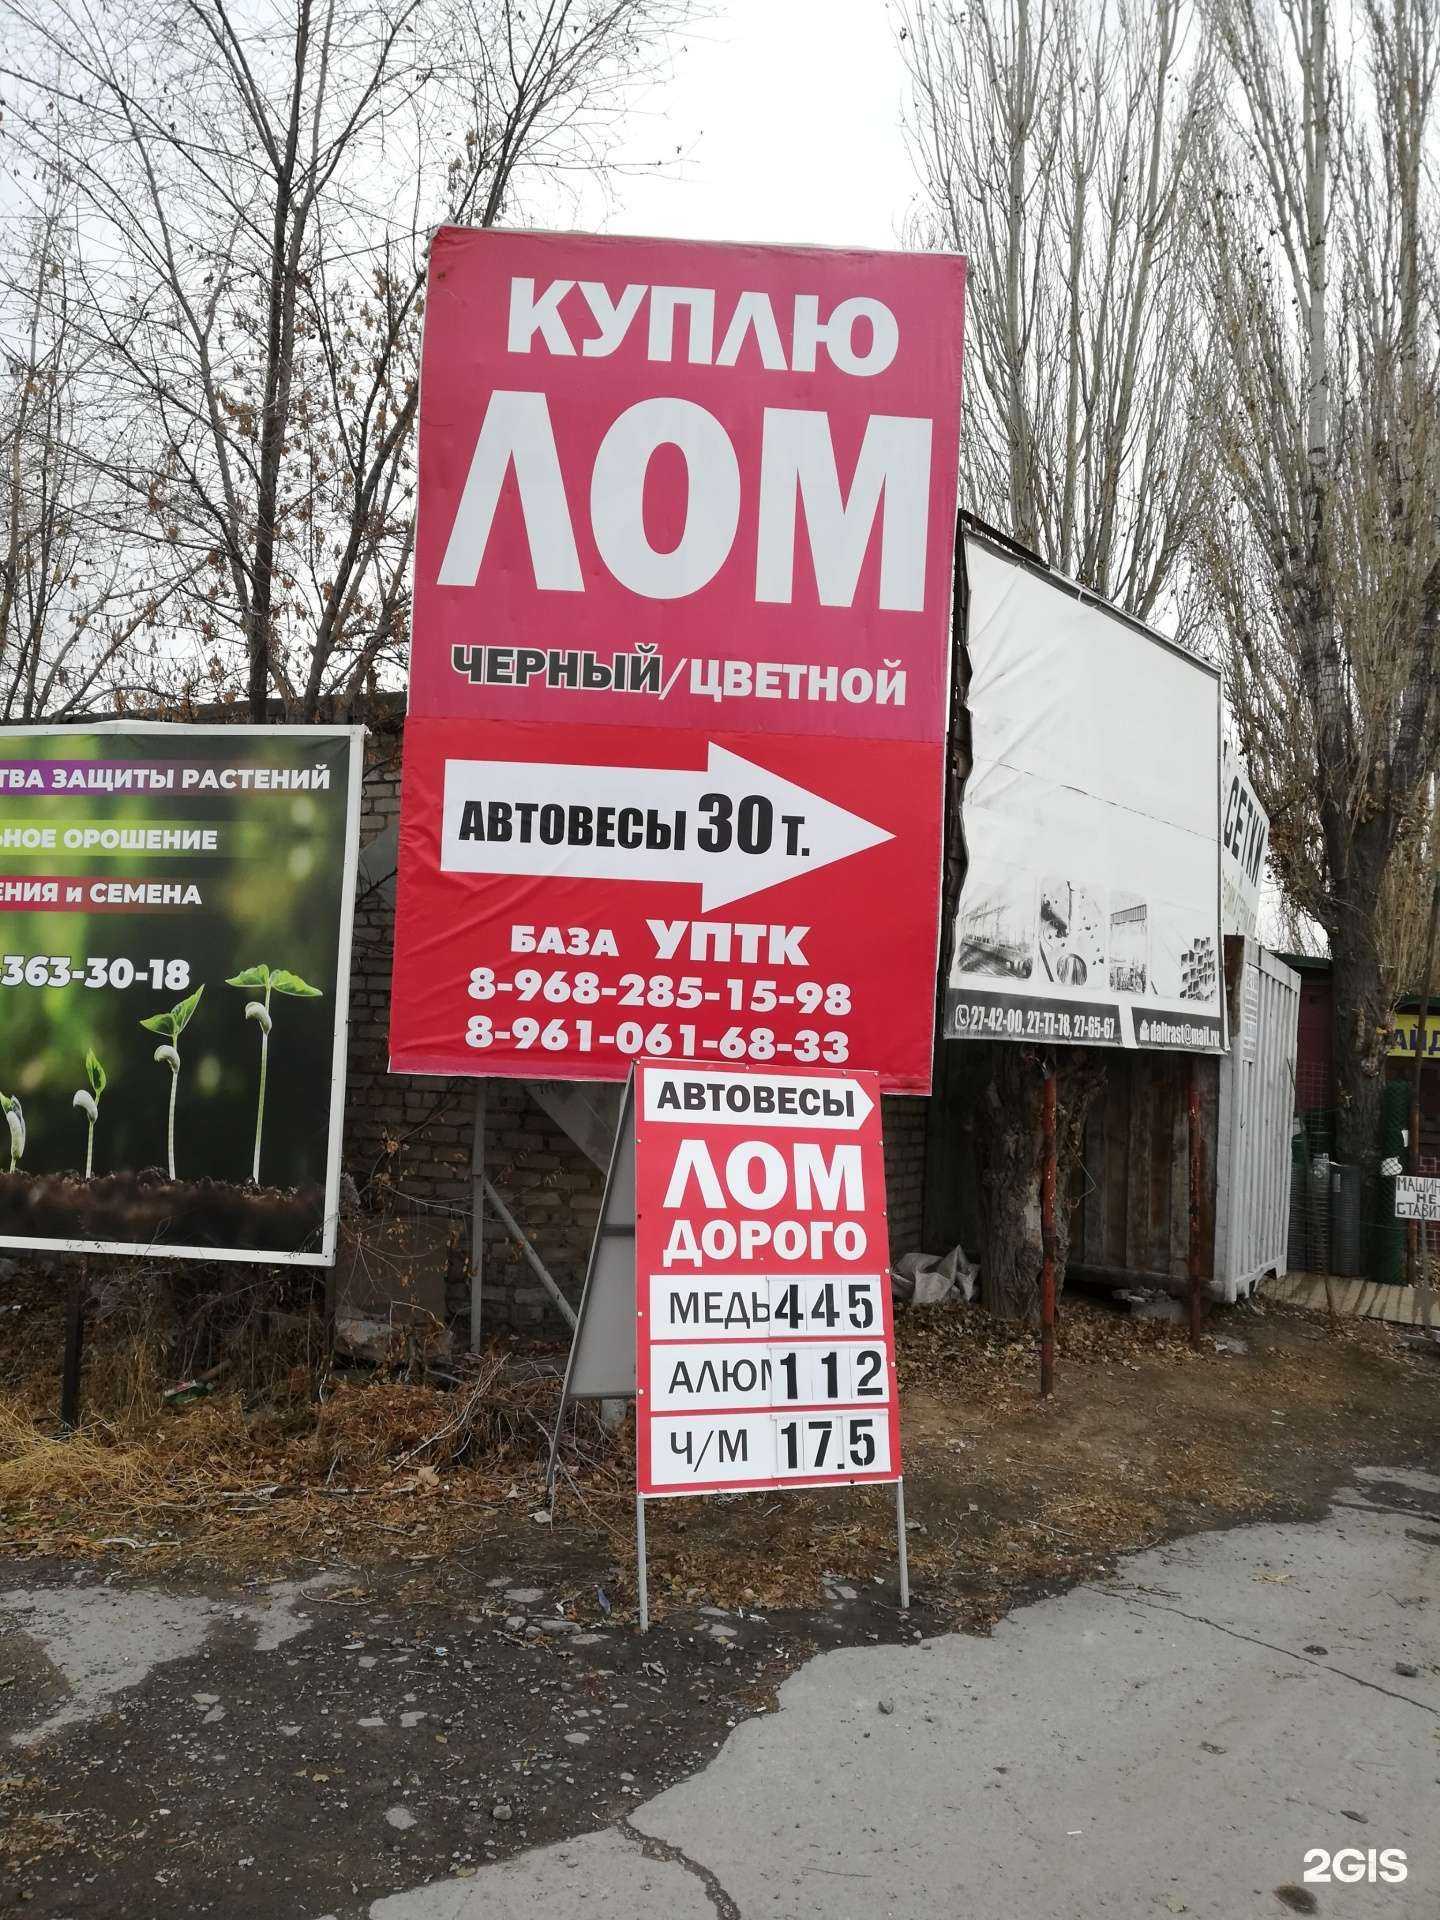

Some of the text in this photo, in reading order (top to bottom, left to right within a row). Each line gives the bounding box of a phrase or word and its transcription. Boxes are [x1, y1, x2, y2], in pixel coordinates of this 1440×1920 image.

[507, 277, 899, 376] КУПЛЮ
[436, 389, 933, 612] ЛОМ
[51, 768, 174, 791] ЗАЩИТЫ
[182, 763, 331, 790] РАСТЕНИЙ
[0, 828, 218, 850] НОЕ ОРОШЕНИЕ
[458, 800, 686, 851] АВТОВЕСЫ
[697, 793, 774, 855] 30
[90, 883, 203, 905] СЕМЕНА
[510, 919, 811, 966] БАЗА УПТК
[0, 955, 191, 990] 363-30-18
[467, 967, 852, 1016] 8-968-285-15-98
[465, 1016, 849, 1064] 8-961-061-68-33
[657, 1081, 855, 1117] АВТОВЕСЫ
[662, 1139, 865, 1212] ЛОМ
[1416, 1193, 1437, 1205] НЕ
[1397, 1202, 1440, 1218] СТАВИ
[662, 1219, 867, 1268] ДОРОГО
[670, 1283, 874, 1329] МЕДЬ 445
[780, 1350, 883, 1400] 112
[670, 1418, 876, 1472] Ч/М 17.5
